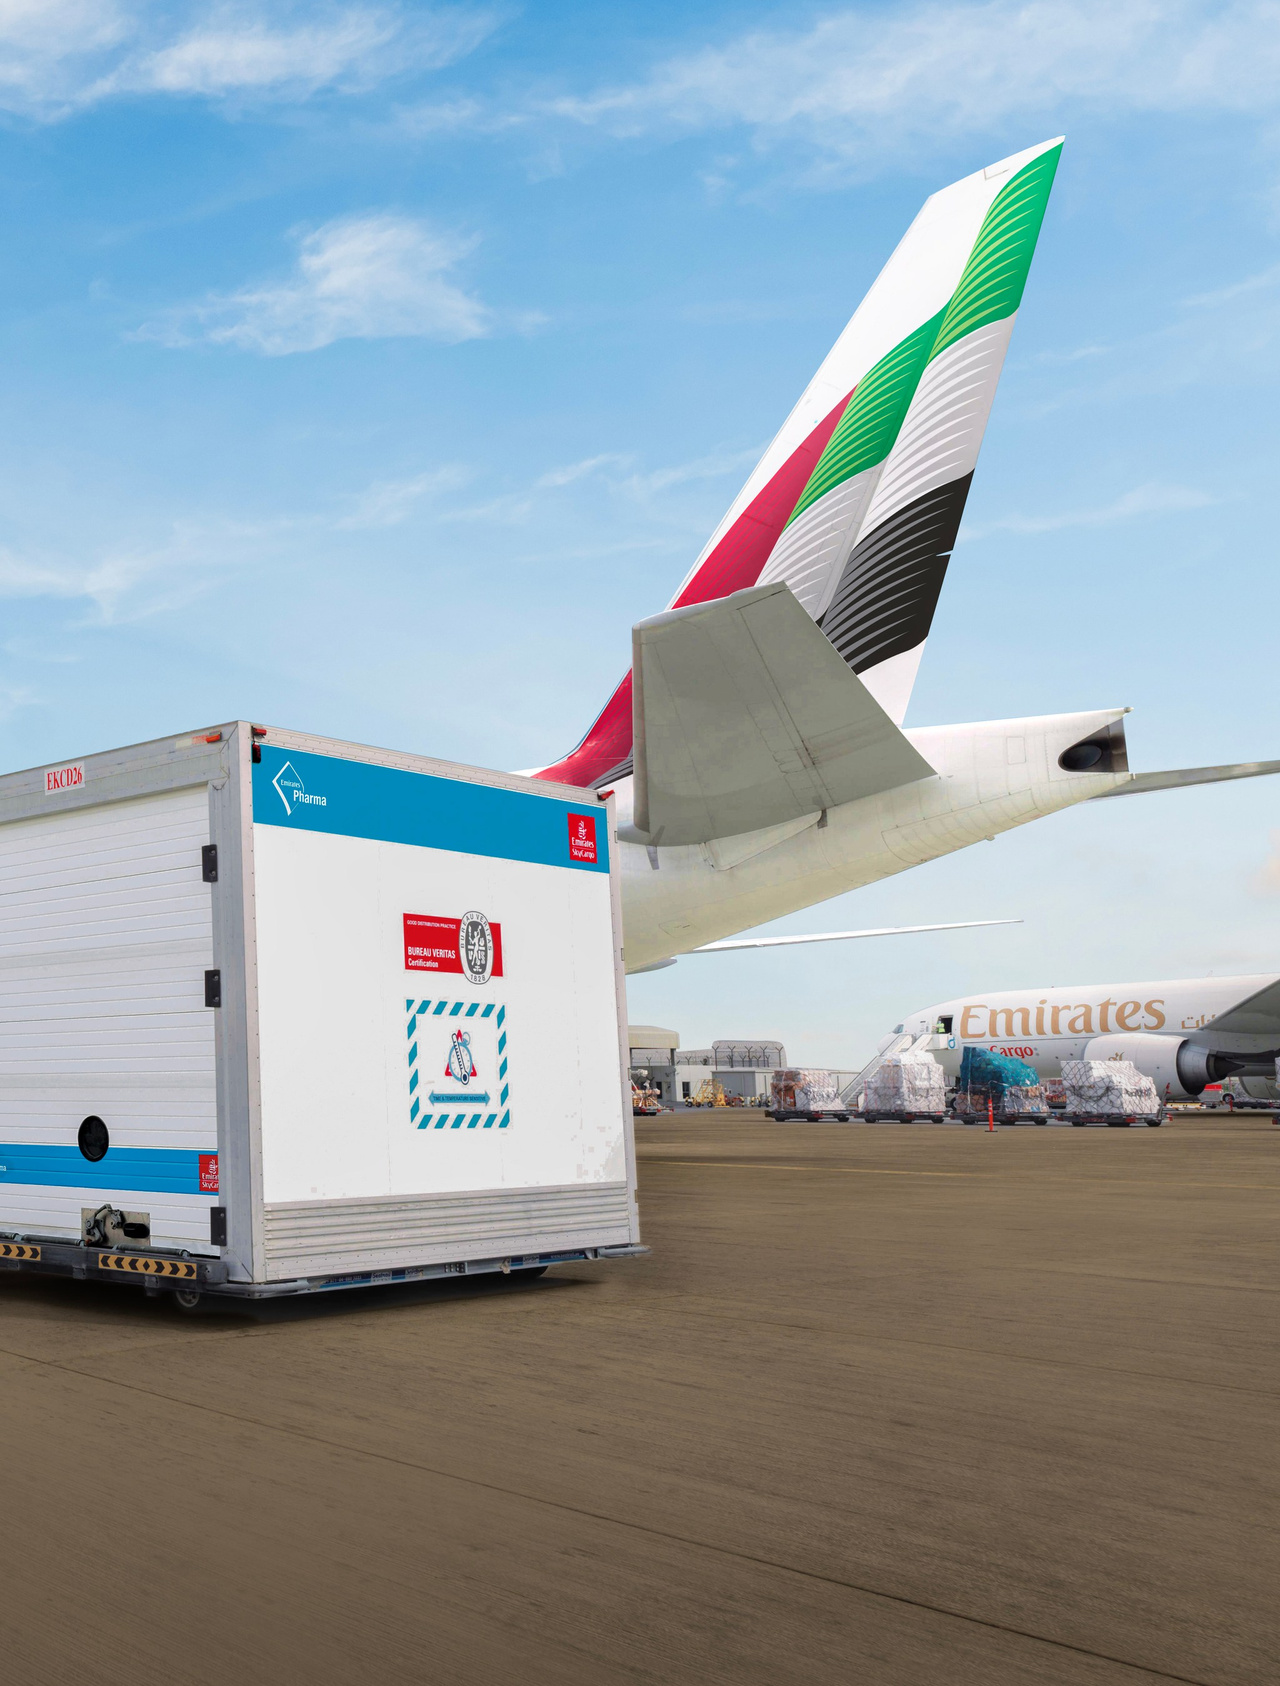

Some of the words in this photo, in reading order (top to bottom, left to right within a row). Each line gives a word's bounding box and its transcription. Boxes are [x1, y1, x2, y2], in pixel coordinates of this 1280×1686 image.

[46, 765, 83, 791] EKCD26
[293, 789, 327, 806] Pharma
[571, 837, 594, 848] Emirates
[572, 848, 595, 859] SkyCargo
[407, 946, 431, 957] BUREAU
[432, 948, 456, 959] VERITAS
[408, 958, 438, 968] Certification
[470, 974, 486, 982] 1828
[960, 997, 1166, 1039] Emirates
[201, 1181, 219, 1189] SkyCar
